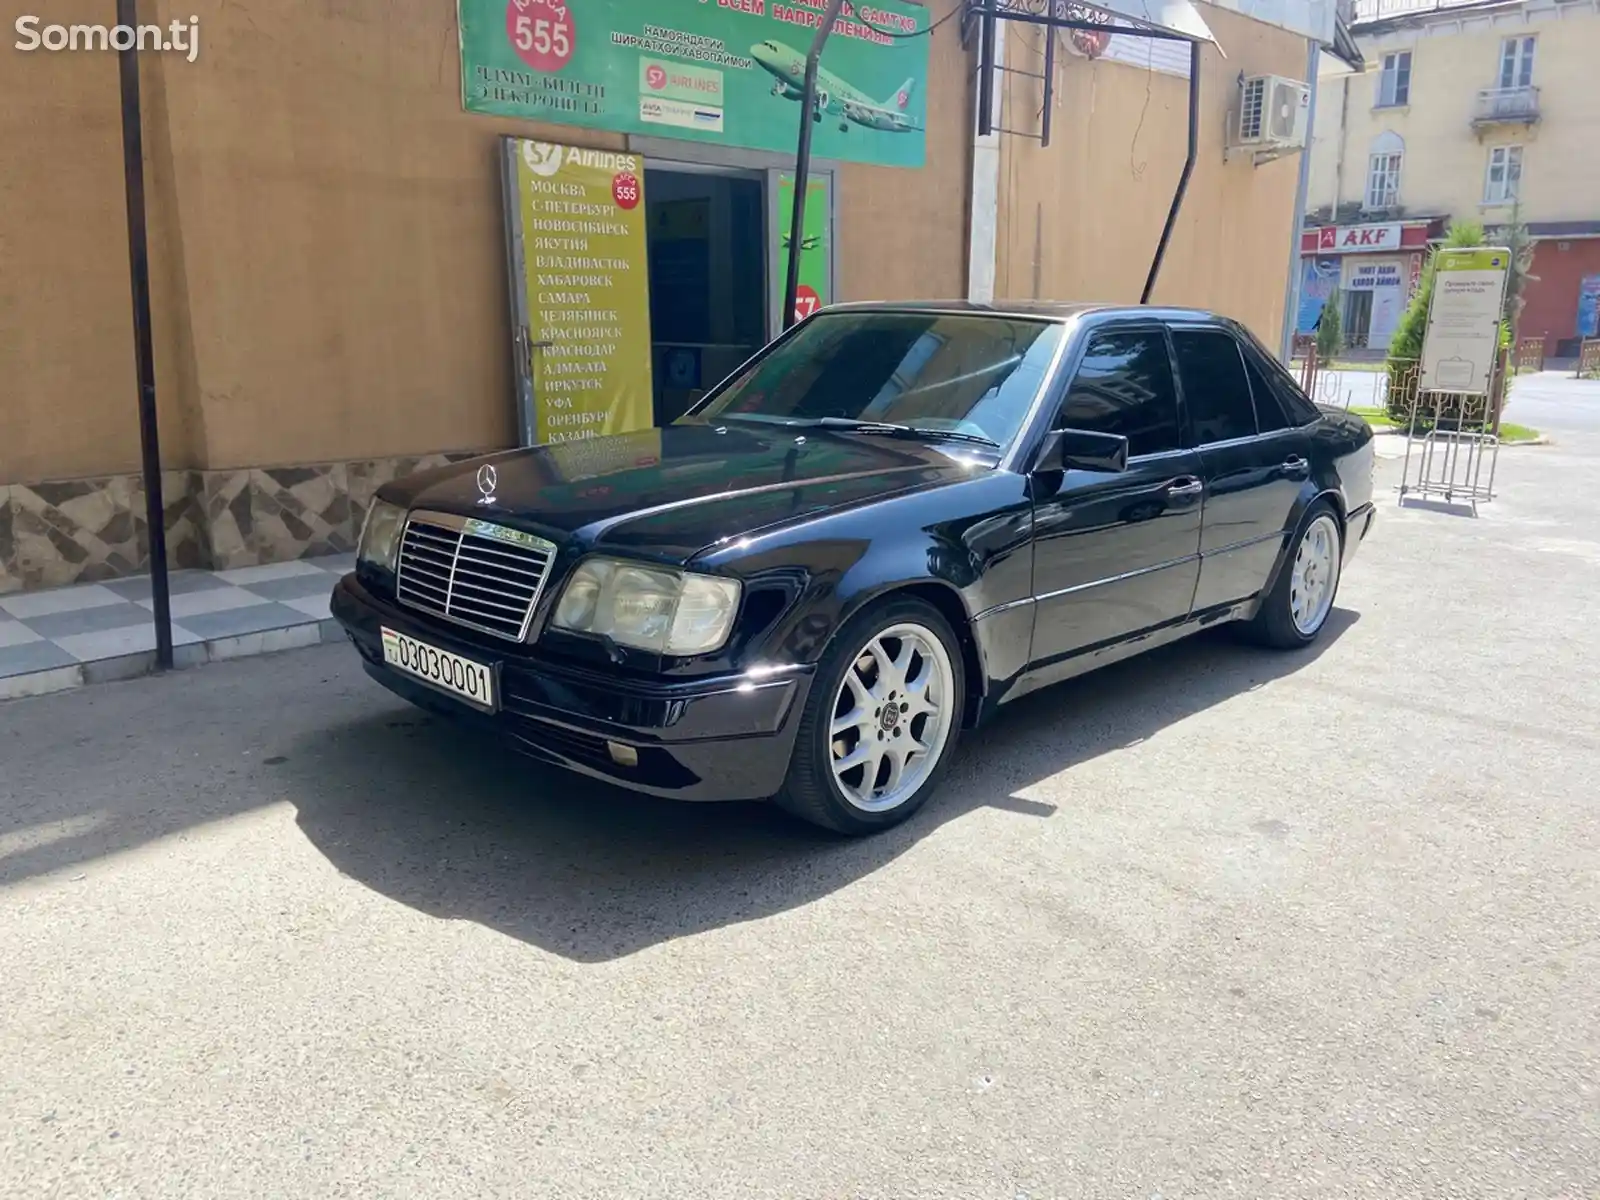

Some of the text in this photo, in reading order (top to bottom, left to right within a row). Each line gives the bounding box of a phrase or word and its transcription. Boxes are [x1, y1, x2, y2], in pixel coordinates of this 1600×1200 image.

[772, 4, 893, 46] НАПРАЛЕНИЯМ
[515, 15, 569, 57] 555
[670, 75, 719, 93] AIRLINES
[565, 147, 637, 171] Airlines
[531, 181, 586, 197] МОСКВА
[616, 187, 636, 200] 555
[532, 200, 616, 217] С-ПЕТЕРБУРГ
[534, 219, 629, 236] НОВОСИБИРСК
[535, 238, 588, 251] ЯКУТИЯ
[1342, 229, 1388, 245] AKF
[537, 274, 613, 287] ХАБАРОВСК
[538, 292, 591, 304] САМАРА
[540, 310, 618, 323] ЧЕЛЯБИНСК
[540, 327, 622, 340] КРАСНОЯРСК
[542, 344, 616, 357] КРАСНОДАР
[544, 361, 607, 375] АЛМА-АТА
[545, 377, 602, 392] ИРКУТСК
[546, 397, 573, 408] УФА
[547, 411, 612, 427] ОРЕНБУРГ
